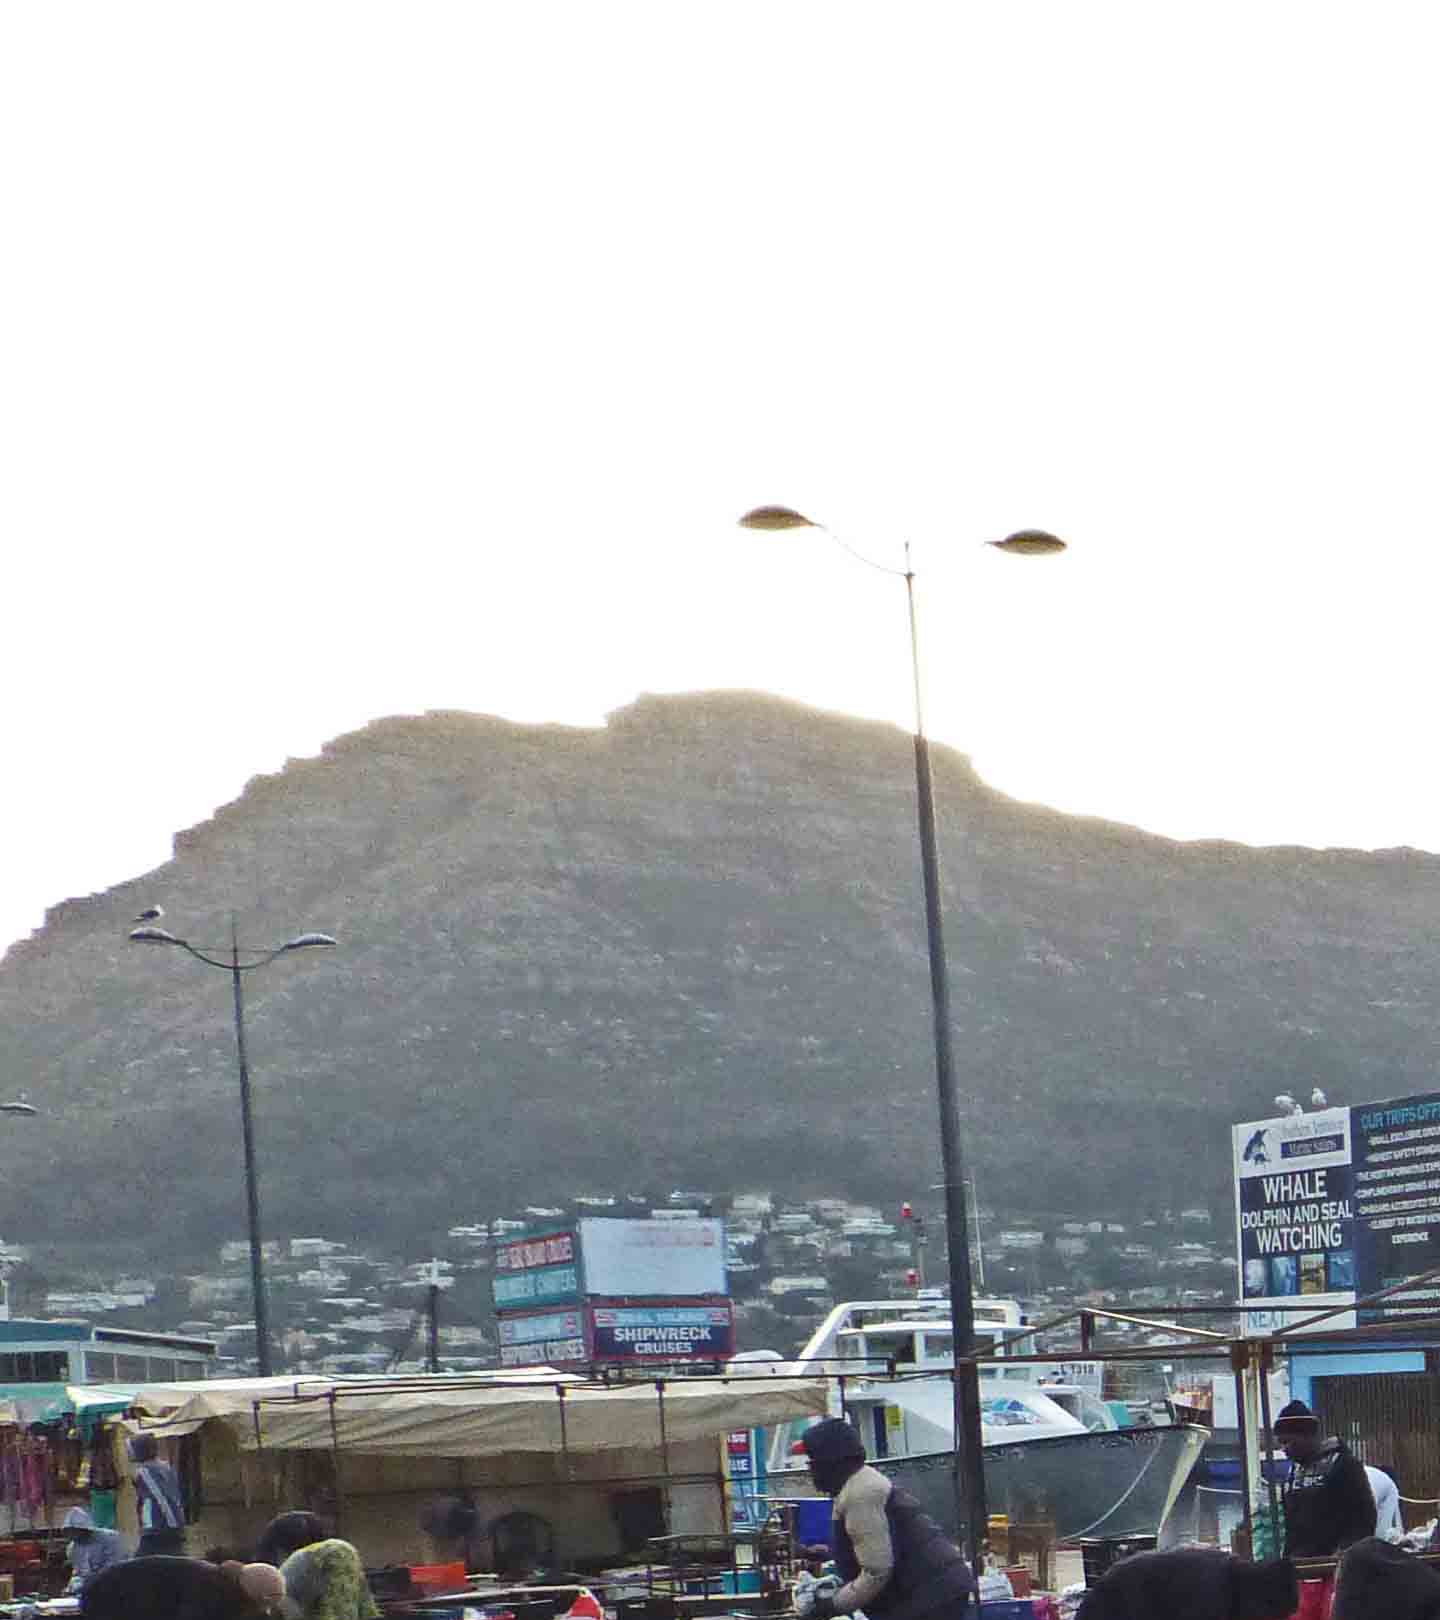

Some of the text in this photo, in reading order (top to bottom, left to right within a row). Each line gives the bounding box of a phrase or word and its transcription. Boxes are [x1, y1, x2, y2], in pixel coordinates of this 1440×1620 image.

[1263, 1171, 1327, 1204] WHALE
[1242, 1200, 1353, 1229] DOLPHIN AND SEAL
[1256, 1223, 1342, 1254] WATCHING
[614, 1327, 712, 1342] SHIPWRECK
[634, 1342, 693, 1354] CRUISES
